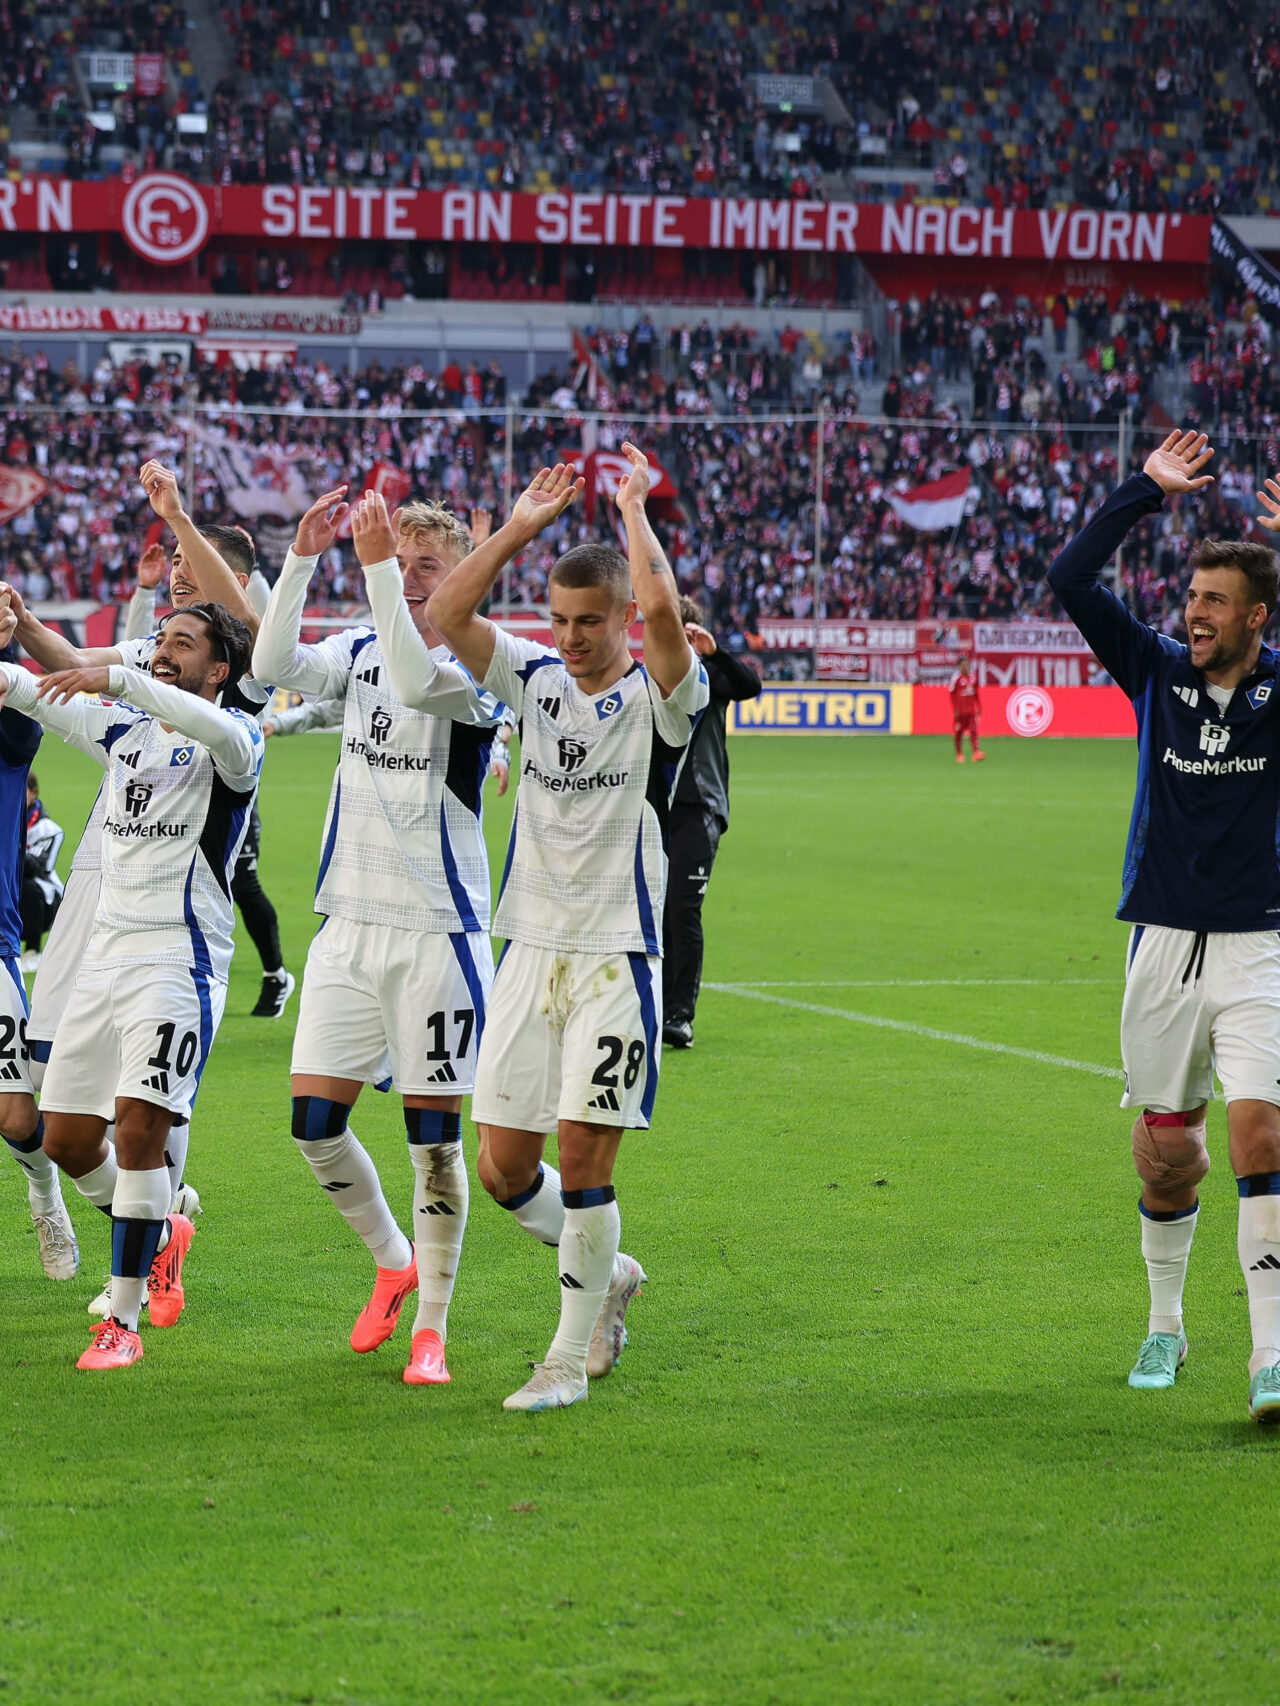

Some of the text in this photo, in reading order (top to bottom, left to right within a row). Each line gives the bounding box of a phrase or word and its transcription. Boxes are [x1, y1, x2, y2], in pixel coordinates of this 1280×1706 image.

[262, 185, 1182, 261] SEITE AN SEITE IMMER NACH VORN'
[739, 692, 886, 726] METRO
[147, 1021, 198, 1078] 10
[426, 1008, 475, 1061] 17
[591, 1035, 646, 1090] 28
